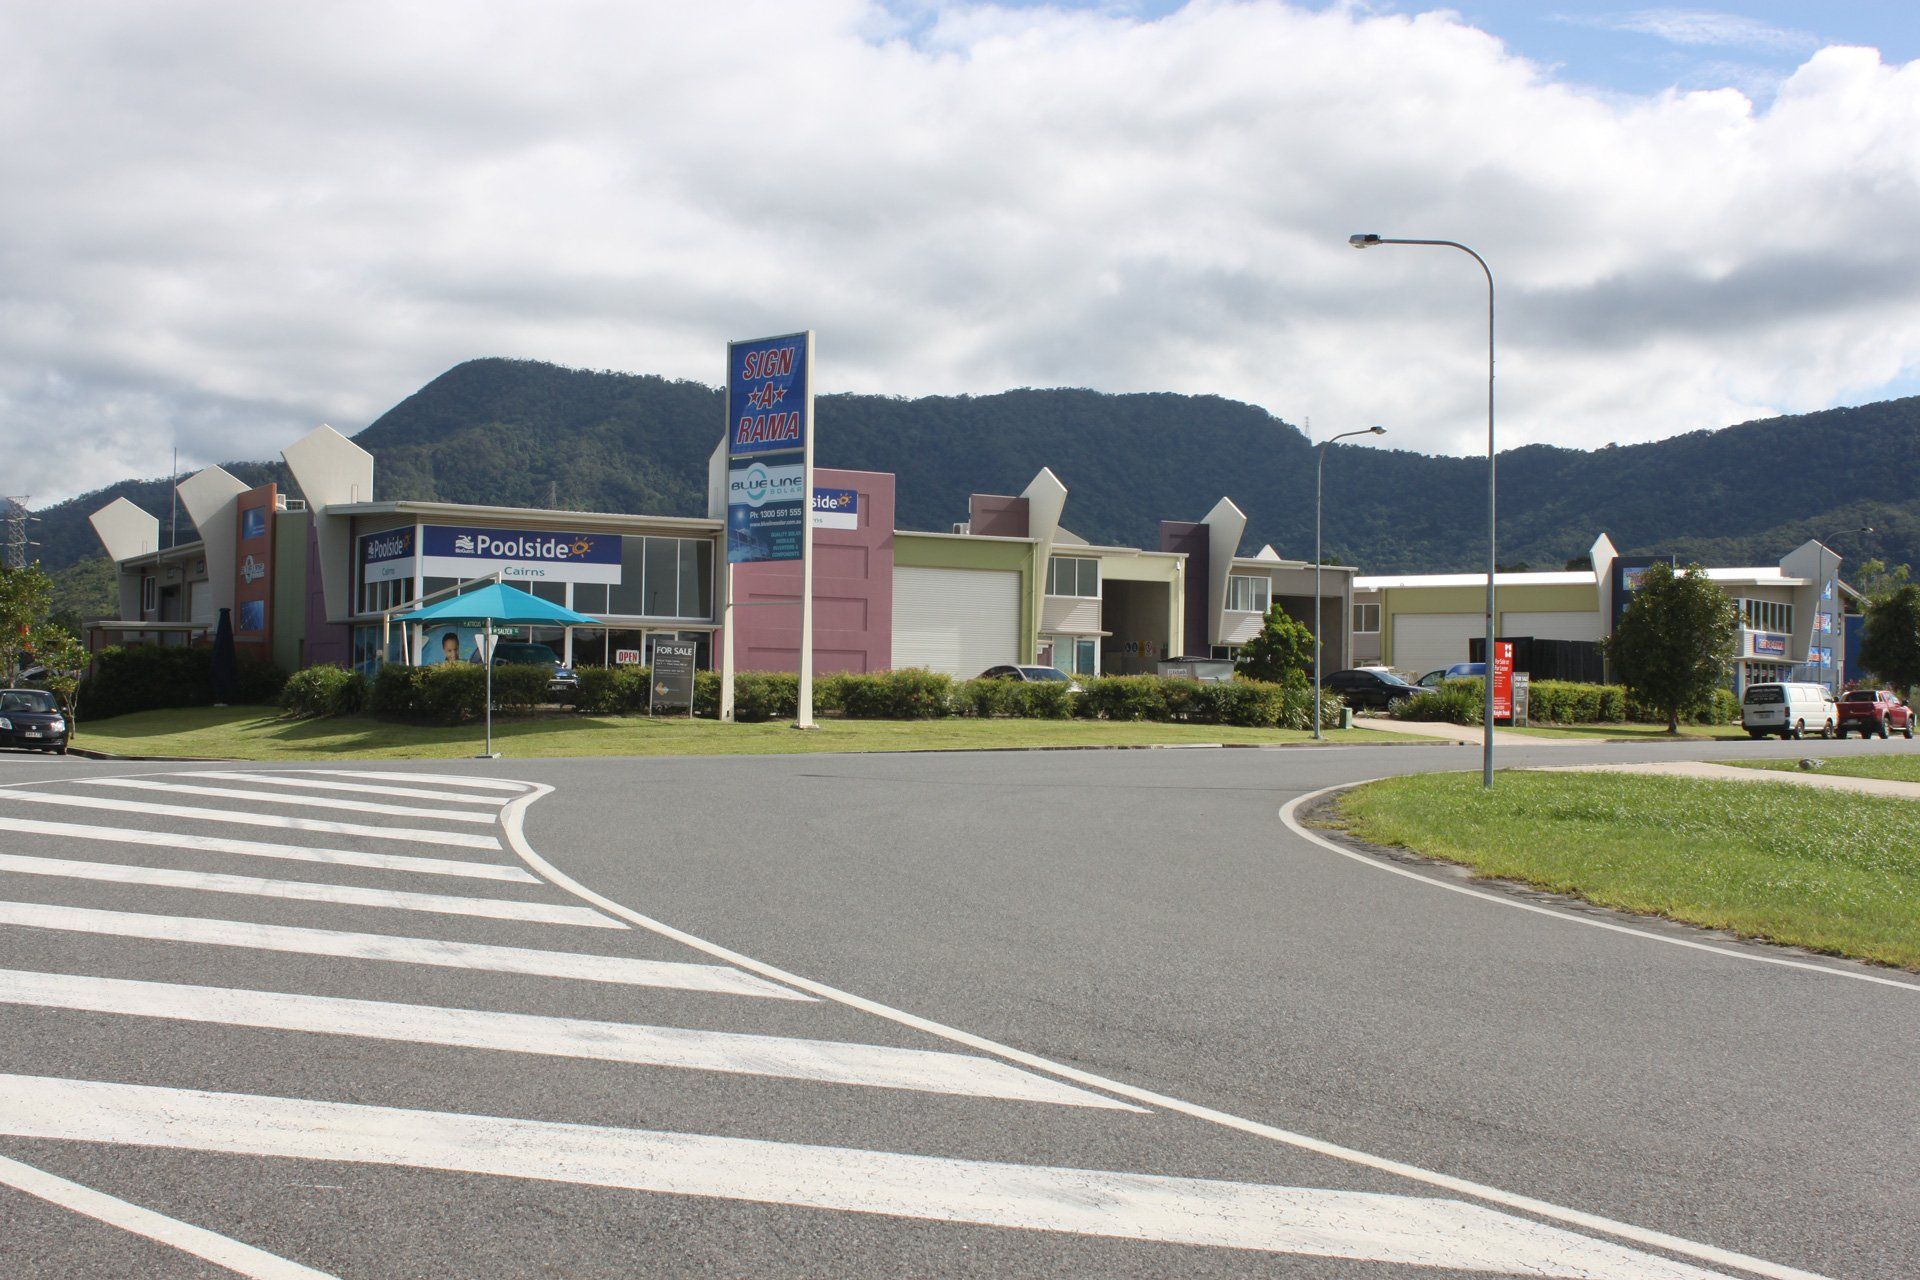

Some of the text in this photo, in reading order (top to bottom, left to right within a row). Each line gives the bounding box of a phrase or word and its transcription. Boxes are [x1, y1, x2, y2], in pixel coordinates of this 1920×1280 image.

[742, 347, 795, 380] SIGN
[736, 411, 799, 444] RAMA
[731, 476, 802, 491] BLUE LINE
[770, 487, 802, 495] SOLAR
[760, 510, 775, 518] 1300
[776, 509, 788, 517] 551
[789, 507, 802, 516] 555
[374, 535, 403, 559] Poolside
[477, 535, 569, 559] Poolside
[504, 566, 545, 577] Cairns
[497, 627, 513, 635] SALTER
[618, 651, 638, 662] OPEN
[656, 646, 693, 656] FOR SALE
